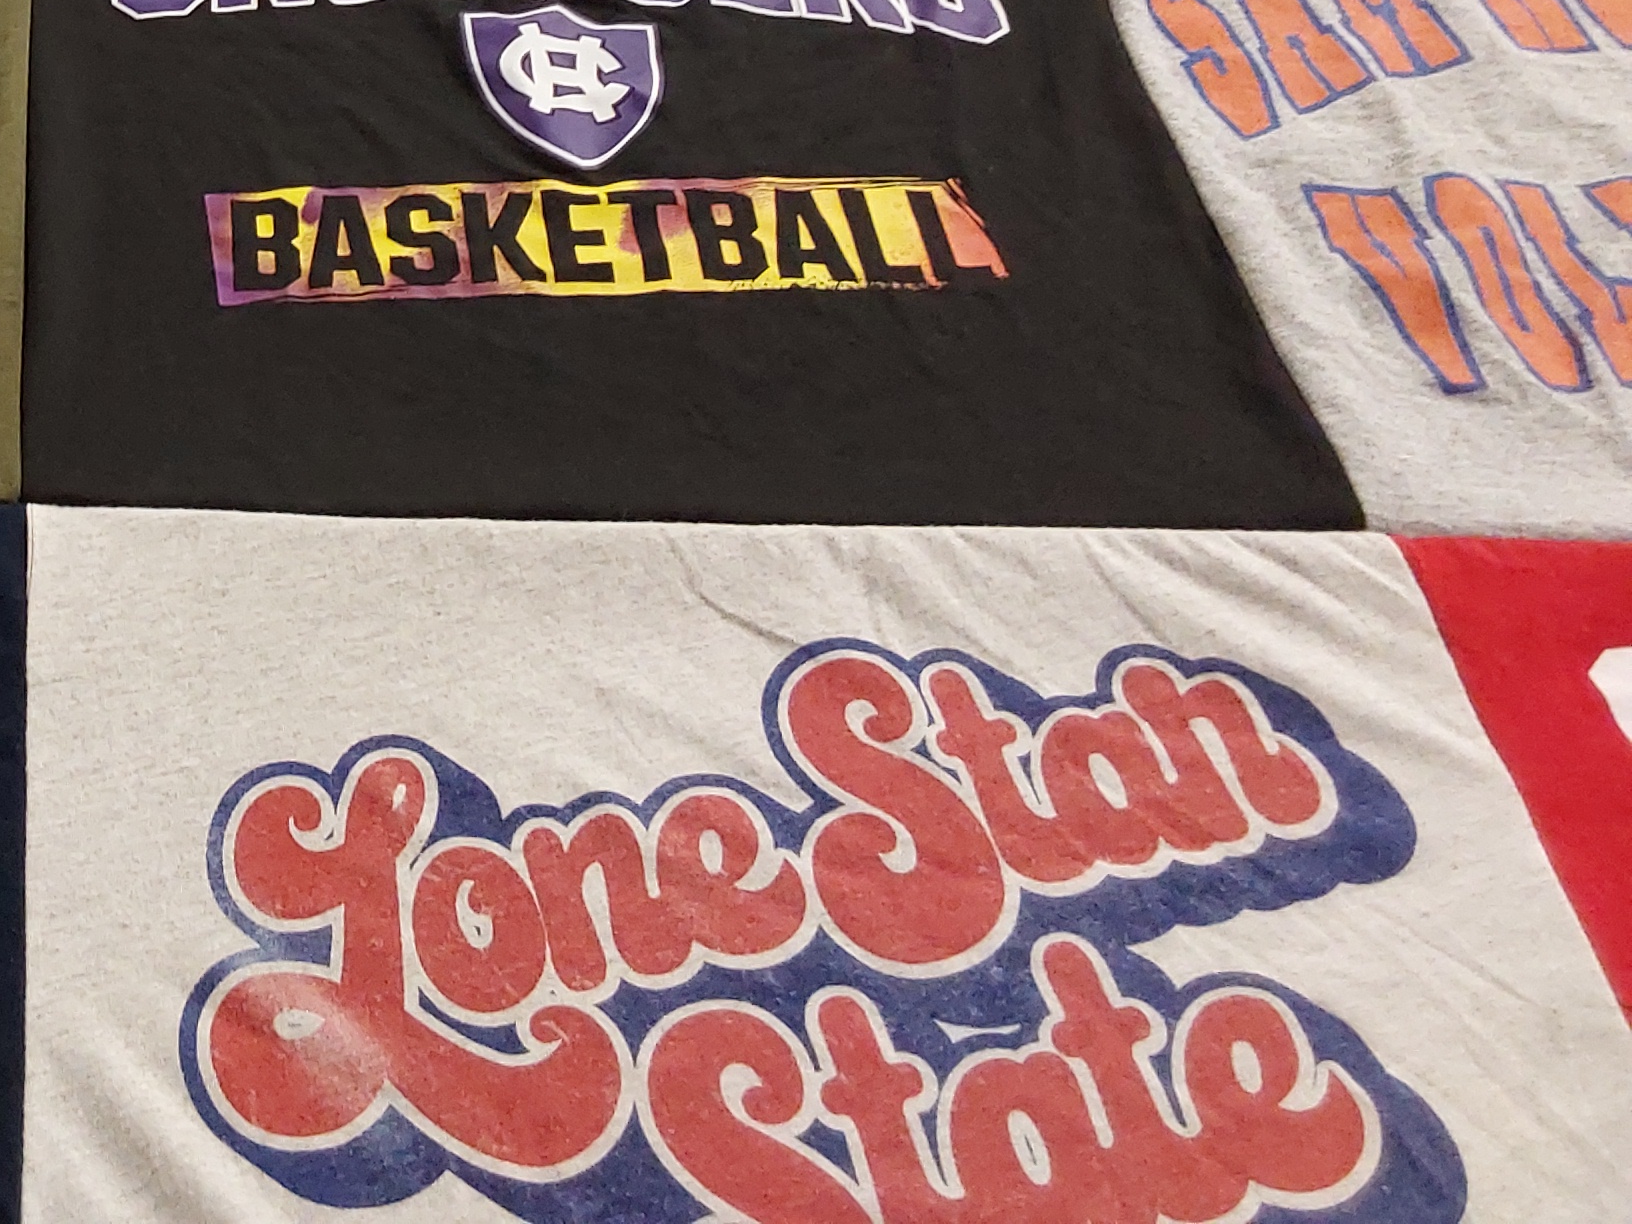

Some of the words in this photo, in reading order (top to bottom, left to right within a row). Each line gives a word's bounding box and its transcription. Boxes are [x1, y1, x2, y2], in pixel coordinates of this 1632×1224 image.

[230, 187, 988, 292] BASKETBALL
[1301, 172, 1632, 393] VOL
[198, 748, 818, 1184] Lone
[776, 650, 1342, 979] Star
[638, 936, 1388, 1224] State
